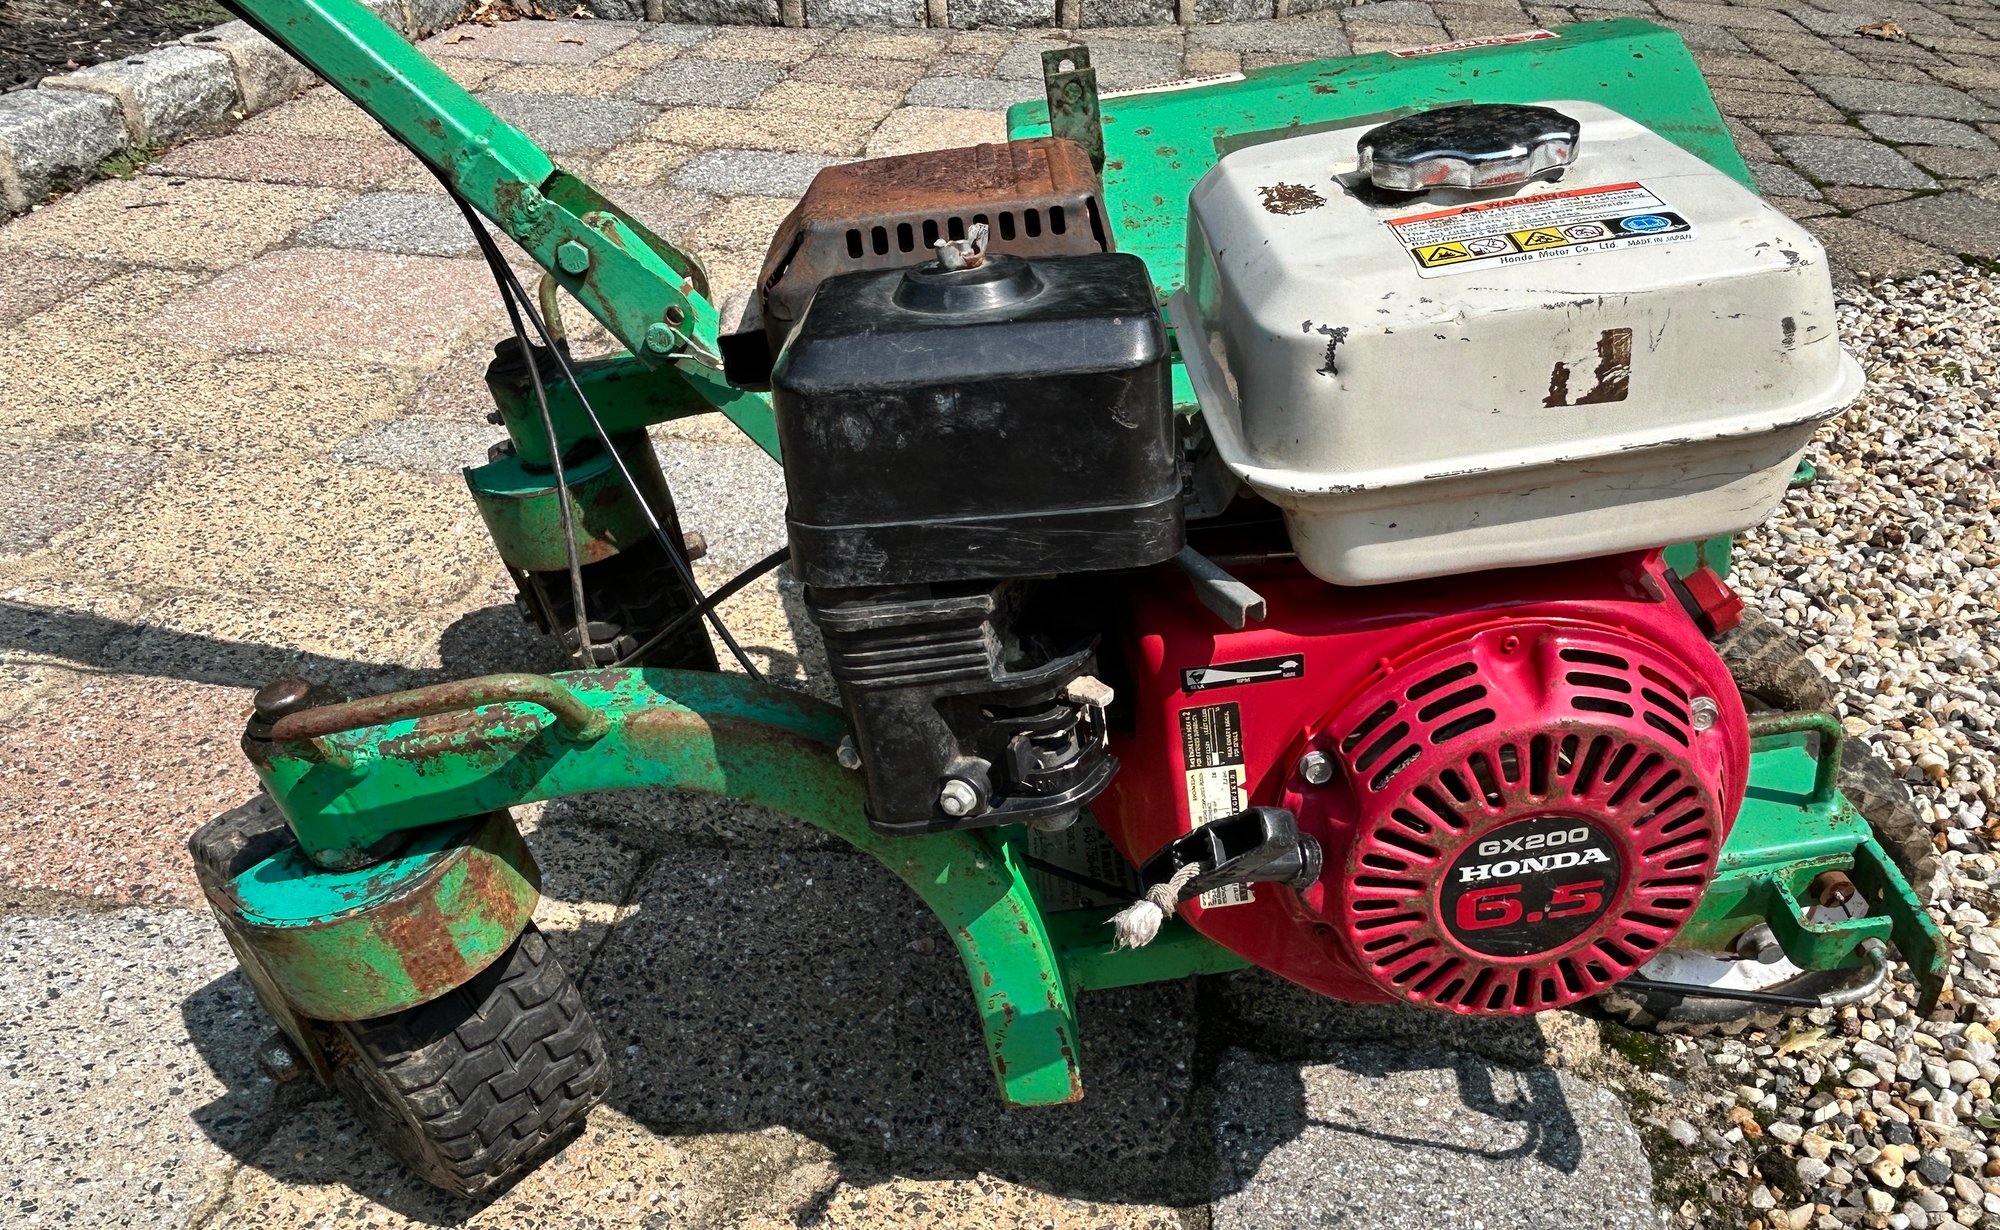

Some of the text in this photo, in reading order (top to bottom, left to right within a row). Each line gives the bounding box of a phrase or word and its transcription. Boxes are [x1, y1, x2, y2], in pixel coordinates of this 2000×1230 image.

[1488, 192, 1571, 208] WARNING
[1500, 241, 1618, 265] Honda Motor Co., Ltd.
[1627, 238, 1652, 247] MADE
[1665, 233, 1692, 243] JAPAN
[1478, 827, 1589, 857] GX200
[1458, 847, 1611, 883] HONDA
[1456, 879, 1605, 931] 6.5
